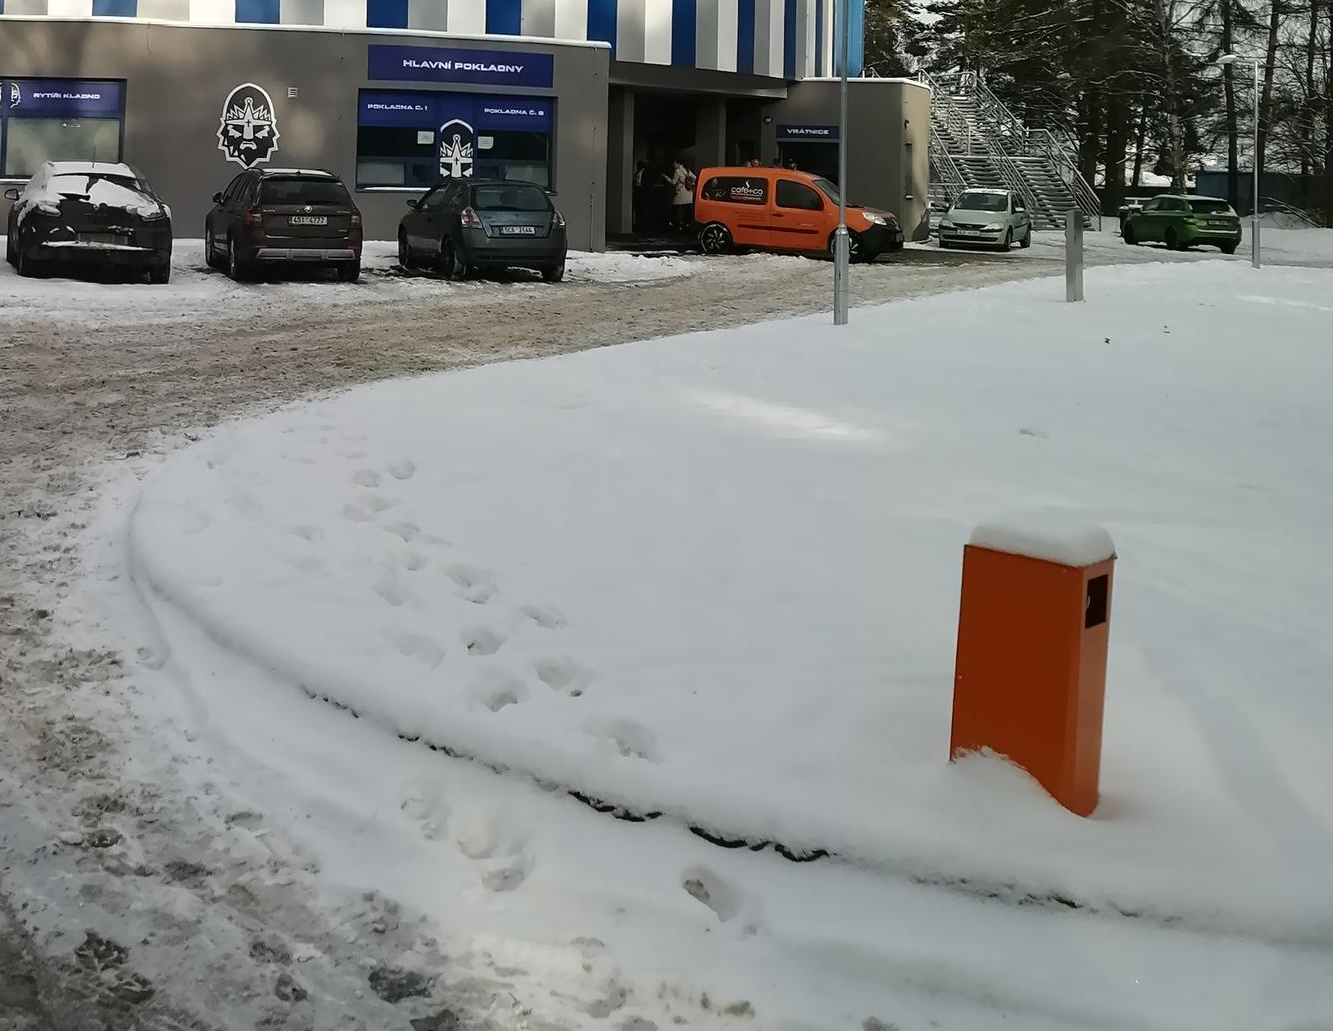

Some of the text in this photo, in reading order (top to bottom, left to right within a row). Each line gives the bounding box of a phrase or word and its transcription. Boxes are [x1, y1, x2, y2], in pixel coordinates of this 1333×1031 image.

[402, 59, 524, 73] HLAVNÍ POKLADNY
[367, 103, 413, 111] POKLADNA
[484, 108, 528, 116] POKLADNA
